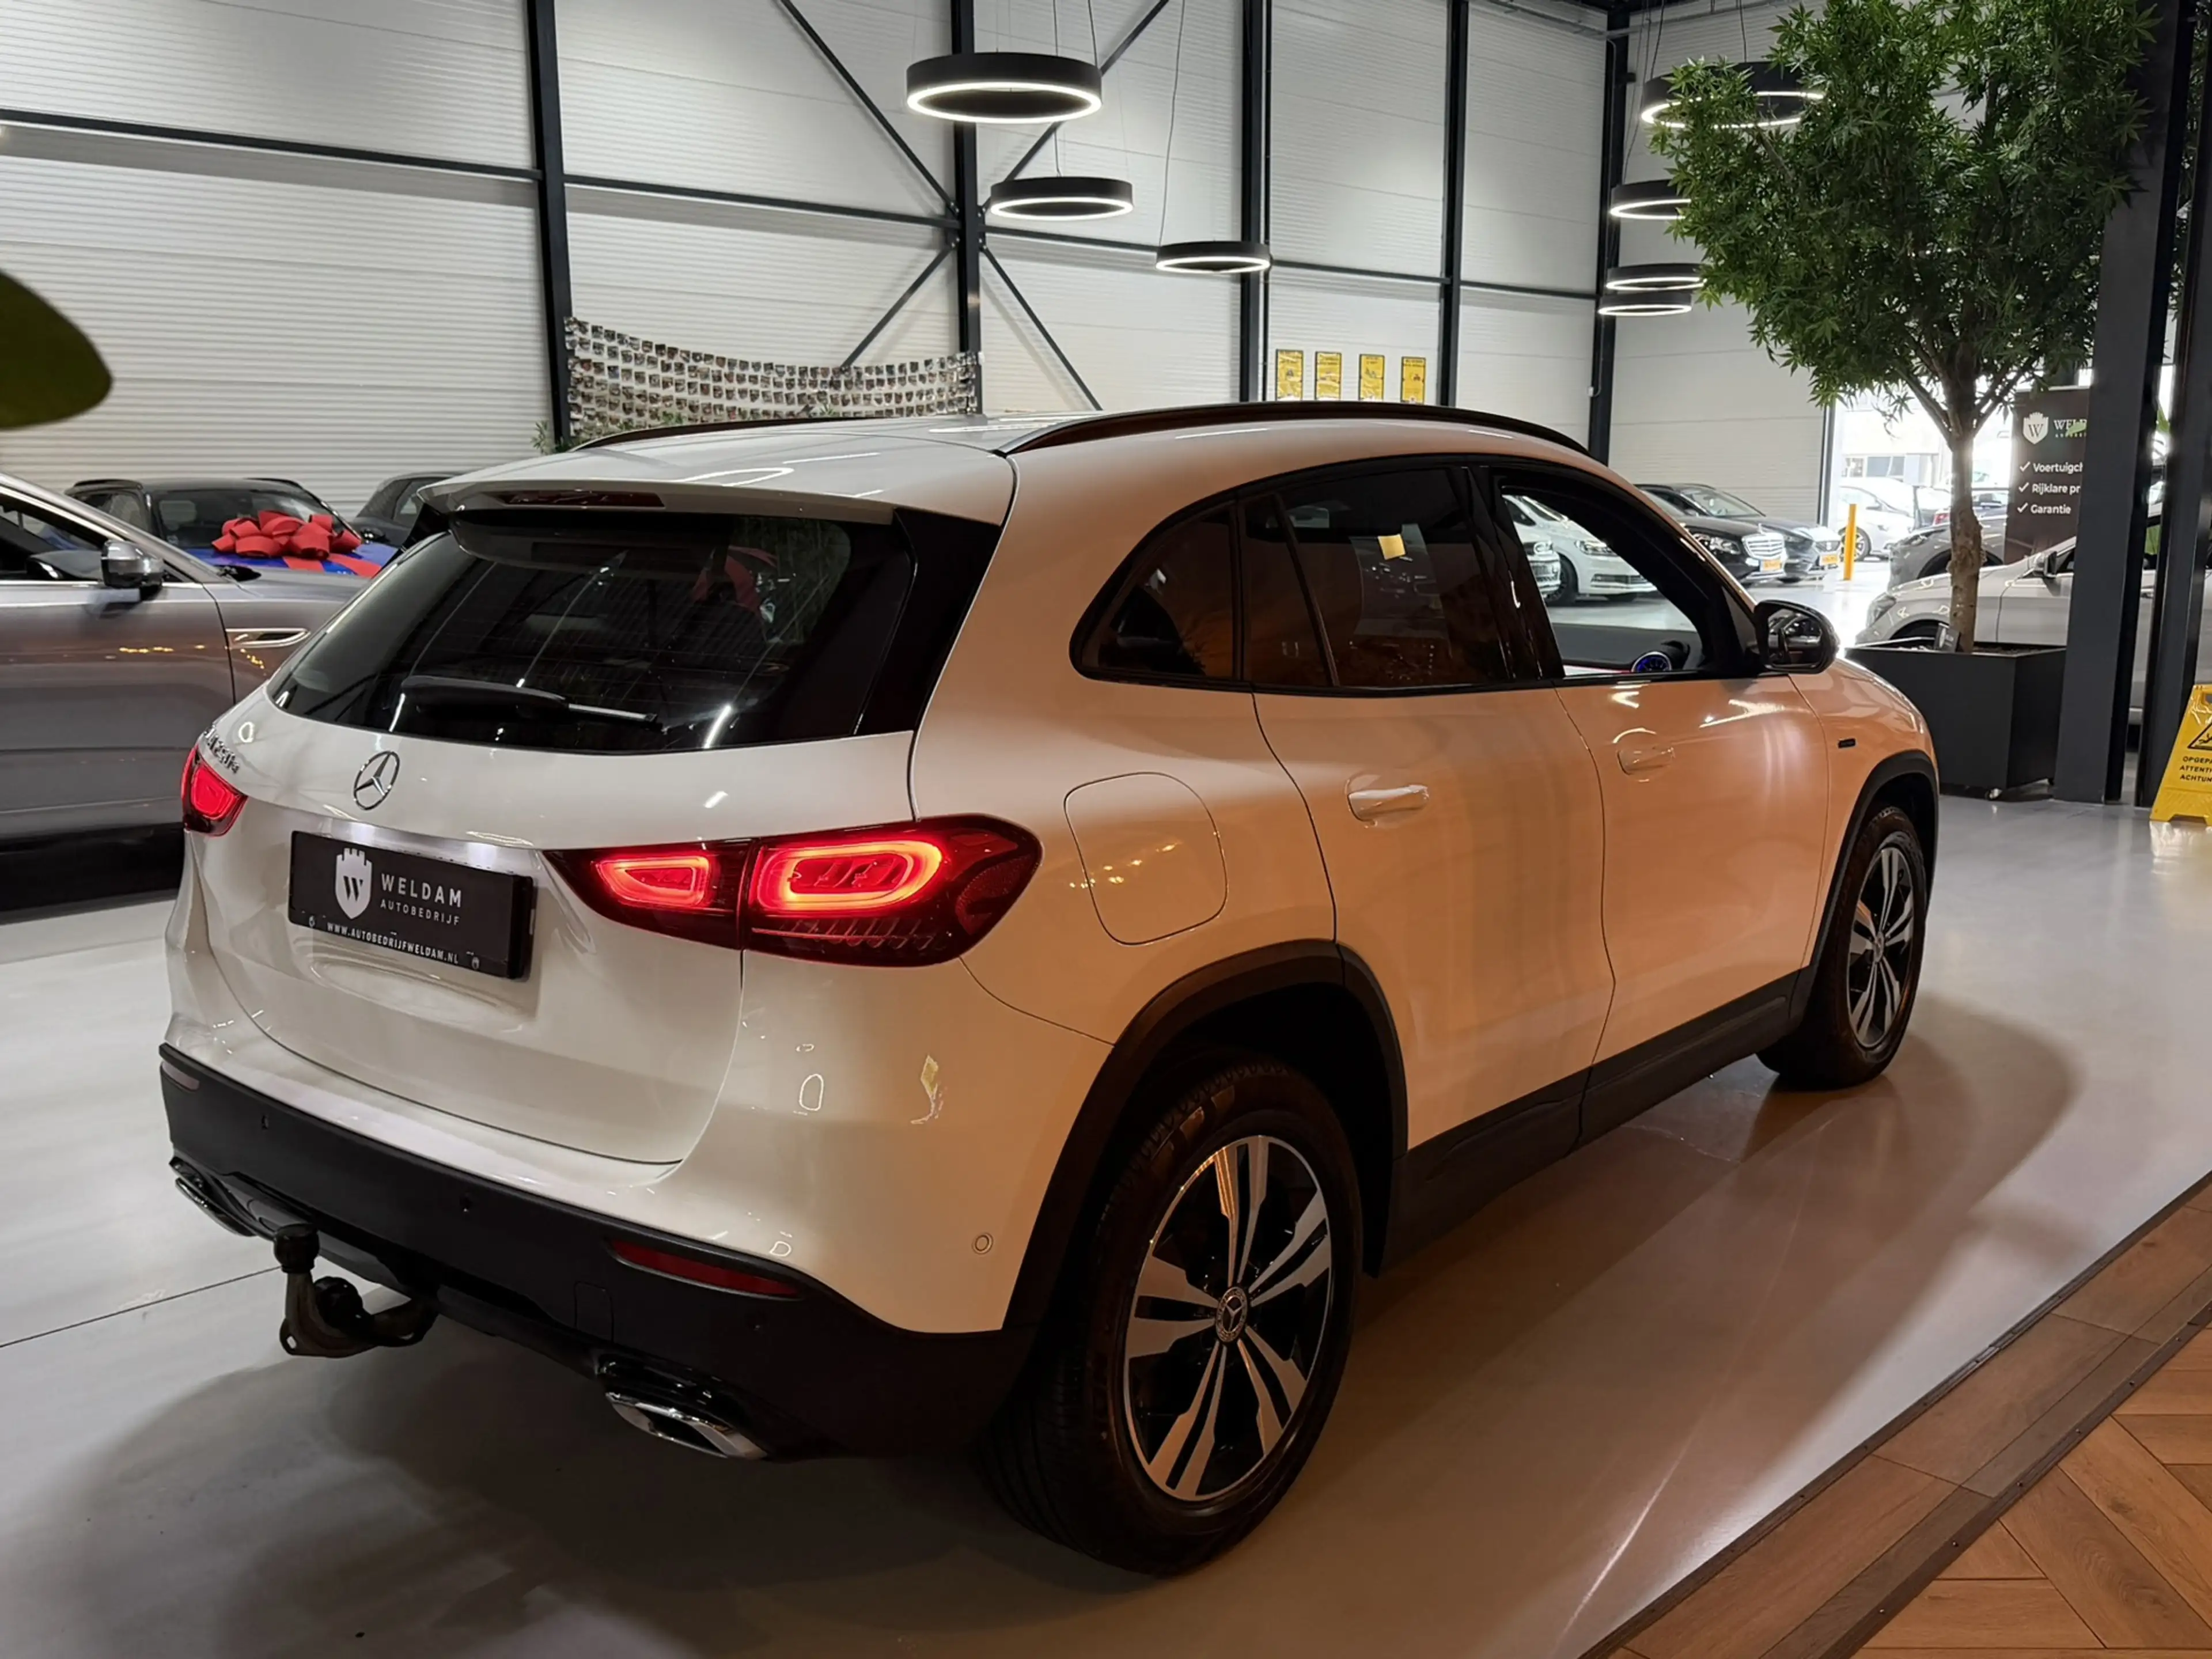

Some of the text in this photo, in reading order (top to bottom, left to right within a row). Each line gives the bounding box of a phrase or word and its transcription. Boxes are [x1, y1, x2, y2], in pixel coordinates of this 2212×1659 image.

[2028, 423, 2043, 437] W
[2032, 483, 2067, 495] Rijklare
[2031, 504, 2071, 514] Garantie
[343, 876, 363, 902] W
[381, 873, 461, 908] WELDAM
[380, 899, 460, 926] AUTOBEDRIJF
[327, 922, 459, 964] WWW.AUTOBEDRIJFWELDAM.NL
